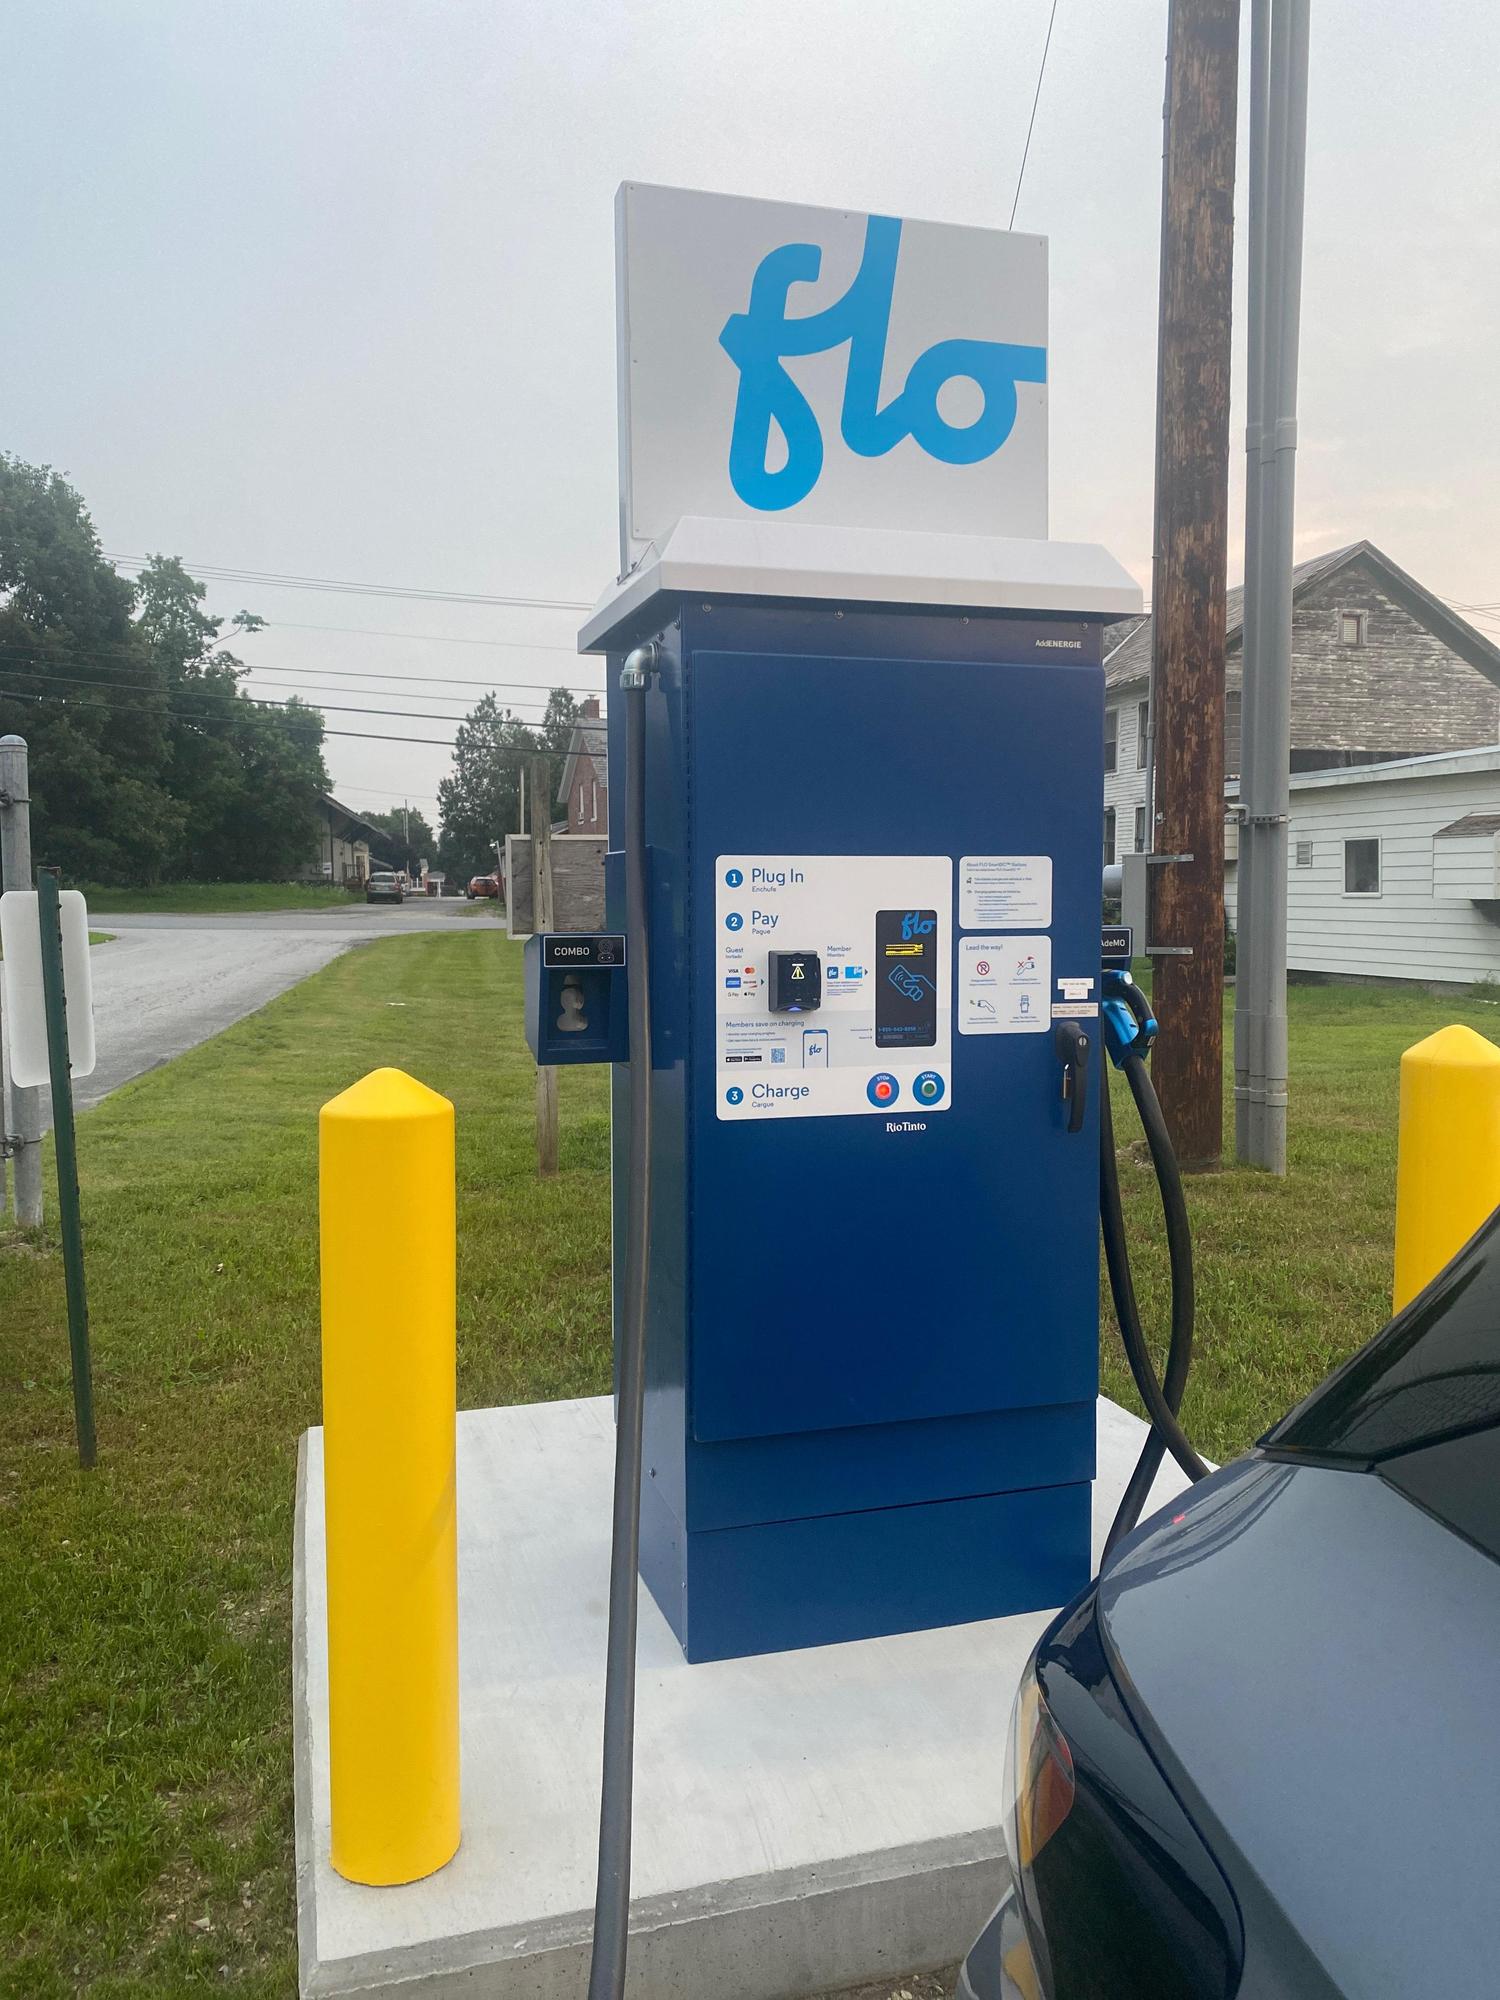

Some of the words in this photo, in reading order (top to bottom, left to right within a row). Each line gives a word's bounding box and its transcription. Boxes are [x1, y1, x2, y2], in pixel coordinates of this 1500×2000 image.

[718, 214, 1047, 511] flo
[751, 868, 786, 886] Plug
[790, 868, 804, 883] In
[751, 910, 779, 928] Pay
[901, 912, 936, 940] flo
[554, 947, 590, 956] COMBO
[778, 1019, 805, 1027] charging
[808, 1043, 822, 1056] flo
[751, 1083, 810, 1100] Charge
